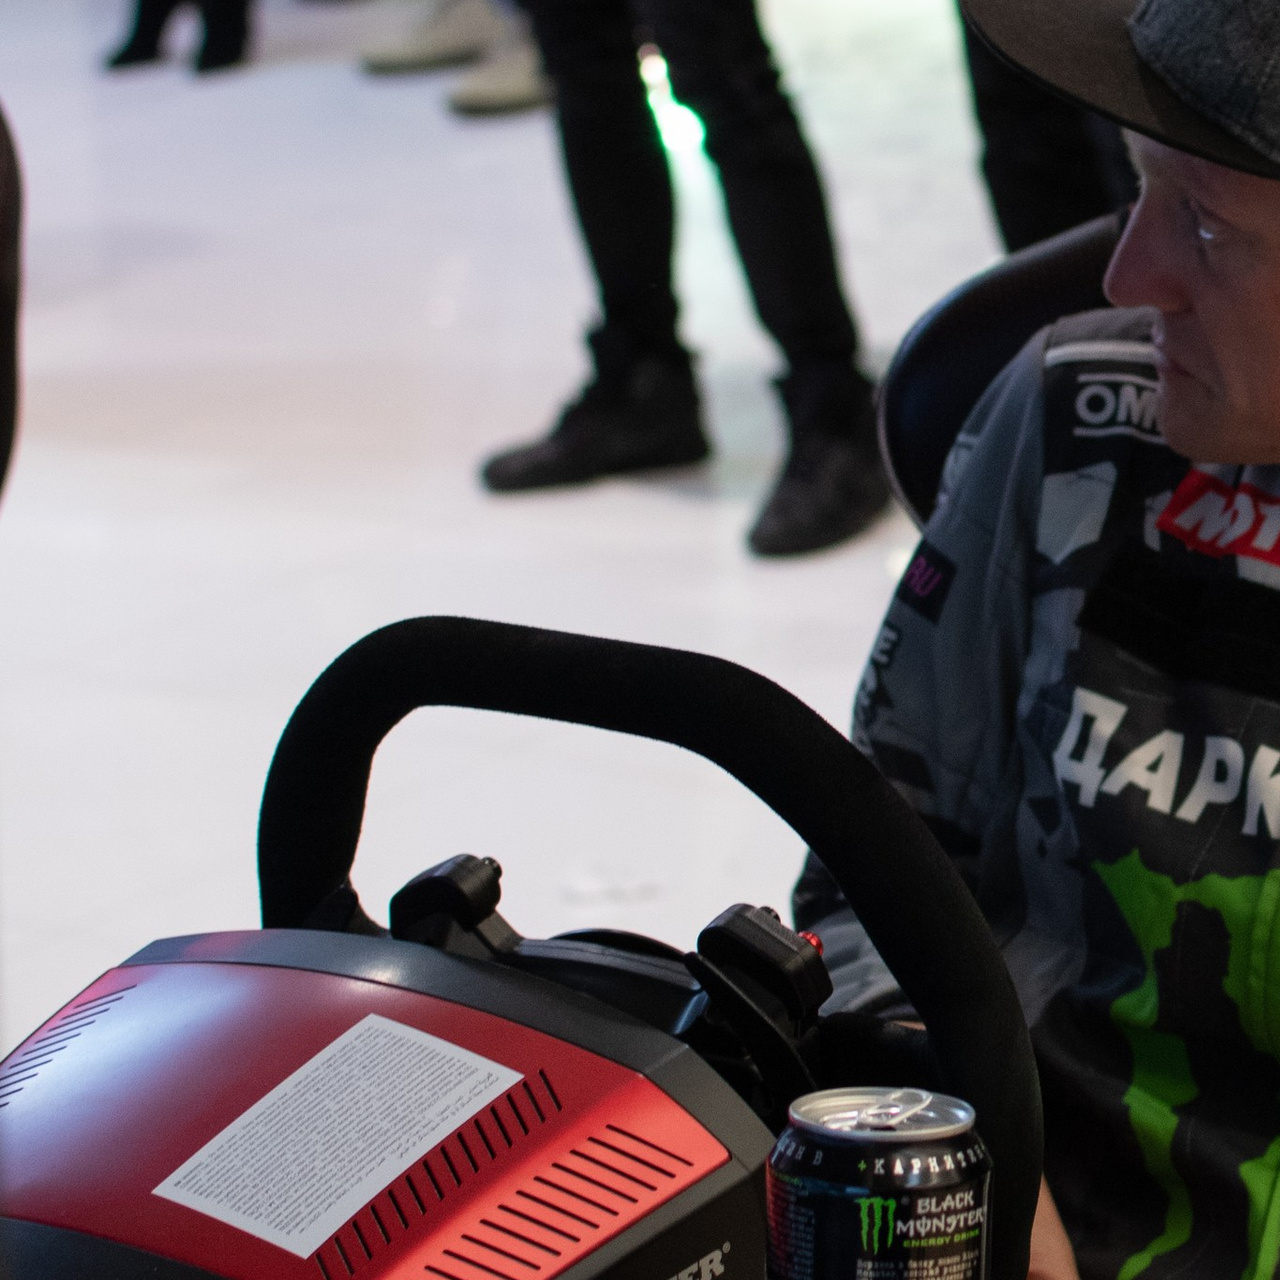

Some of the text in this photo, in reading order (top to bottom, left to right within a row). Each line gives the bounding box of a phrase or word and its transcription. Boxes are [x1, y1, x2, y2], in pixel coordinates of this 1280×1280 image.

[1075, 384, 1160, 428] OM
[917, 1190, 975, 1215] BLACK
[896, 1207, 984, 1238] MONSTER
[903, 1235, 951, 1248] ENERGY
